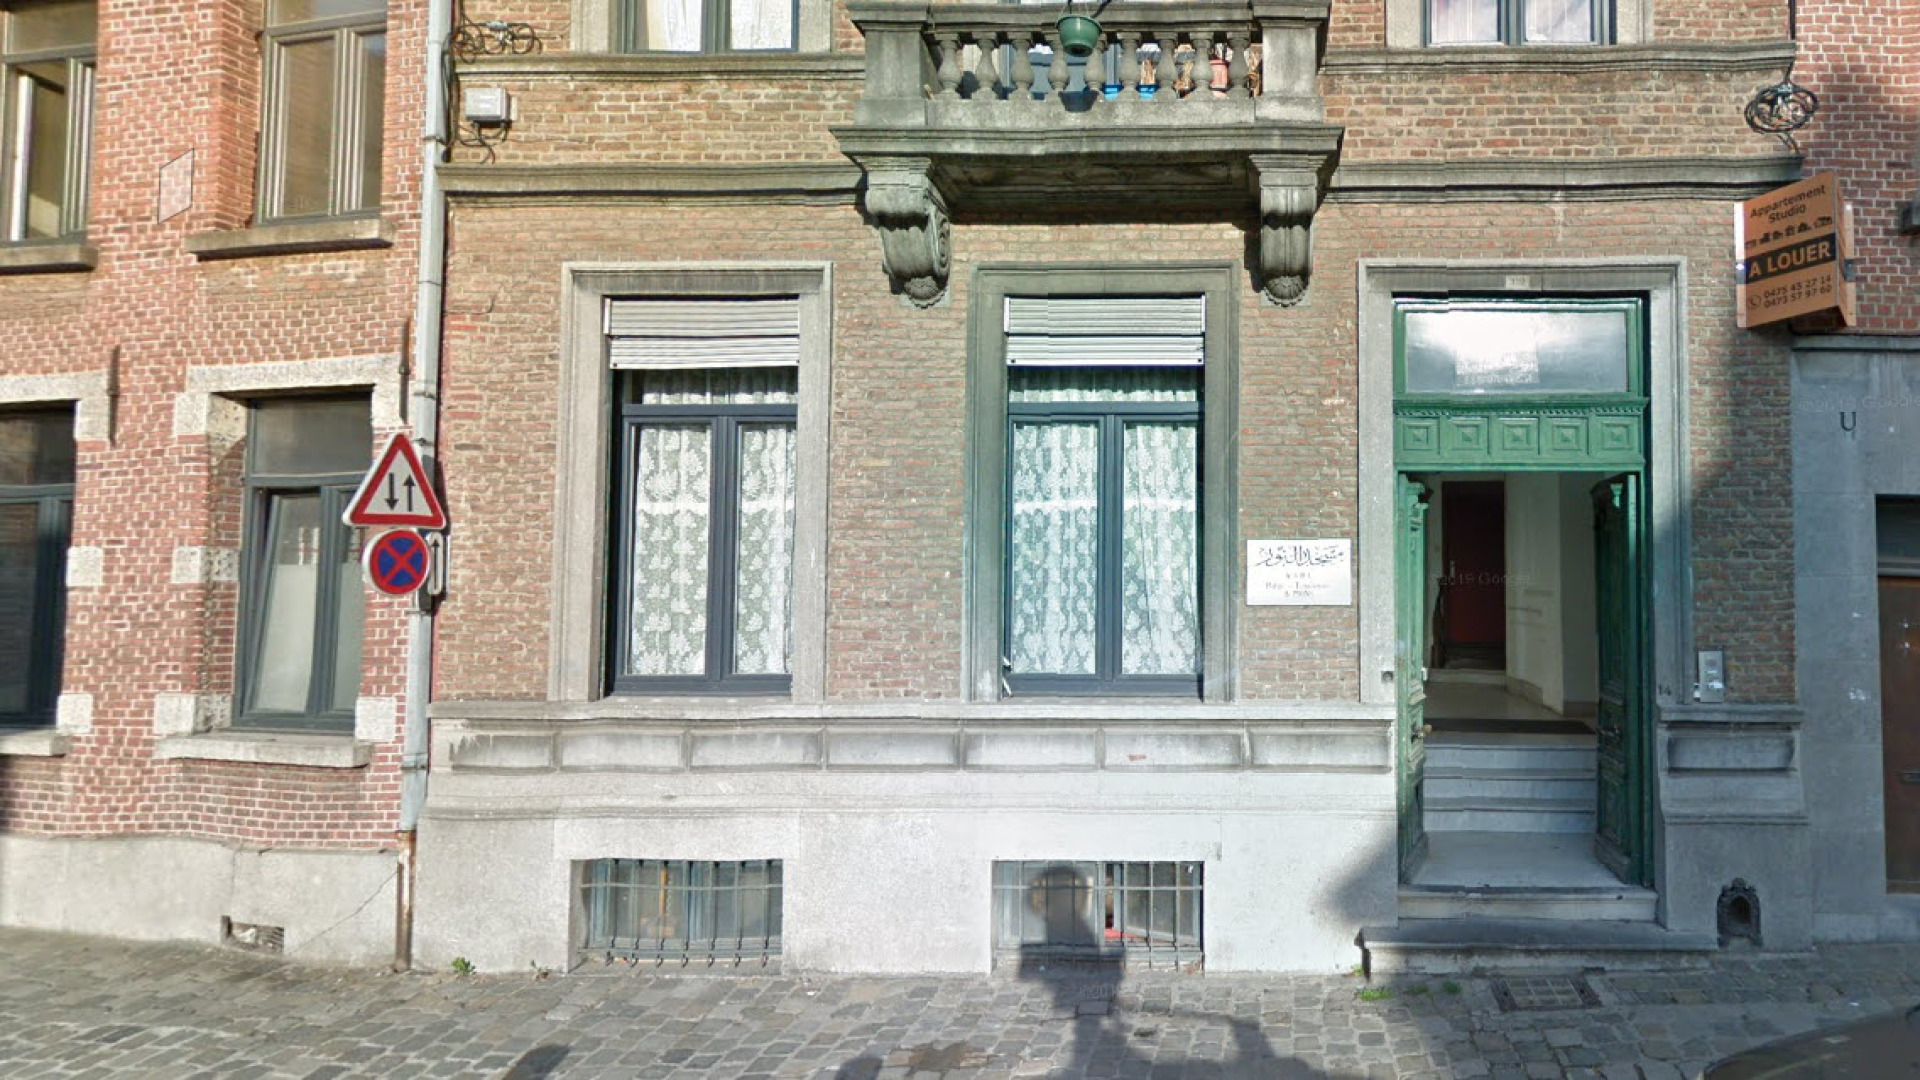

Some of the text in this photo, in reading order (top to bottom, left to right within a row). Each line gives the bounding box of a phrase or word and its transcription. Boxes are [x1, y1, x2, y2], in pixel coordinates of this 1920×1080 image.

[1750, 184, 1826, 219] Appartement
[1768, 203, 1806, 224] Studio
[1748, 241, 1832, 278] A LOUER
